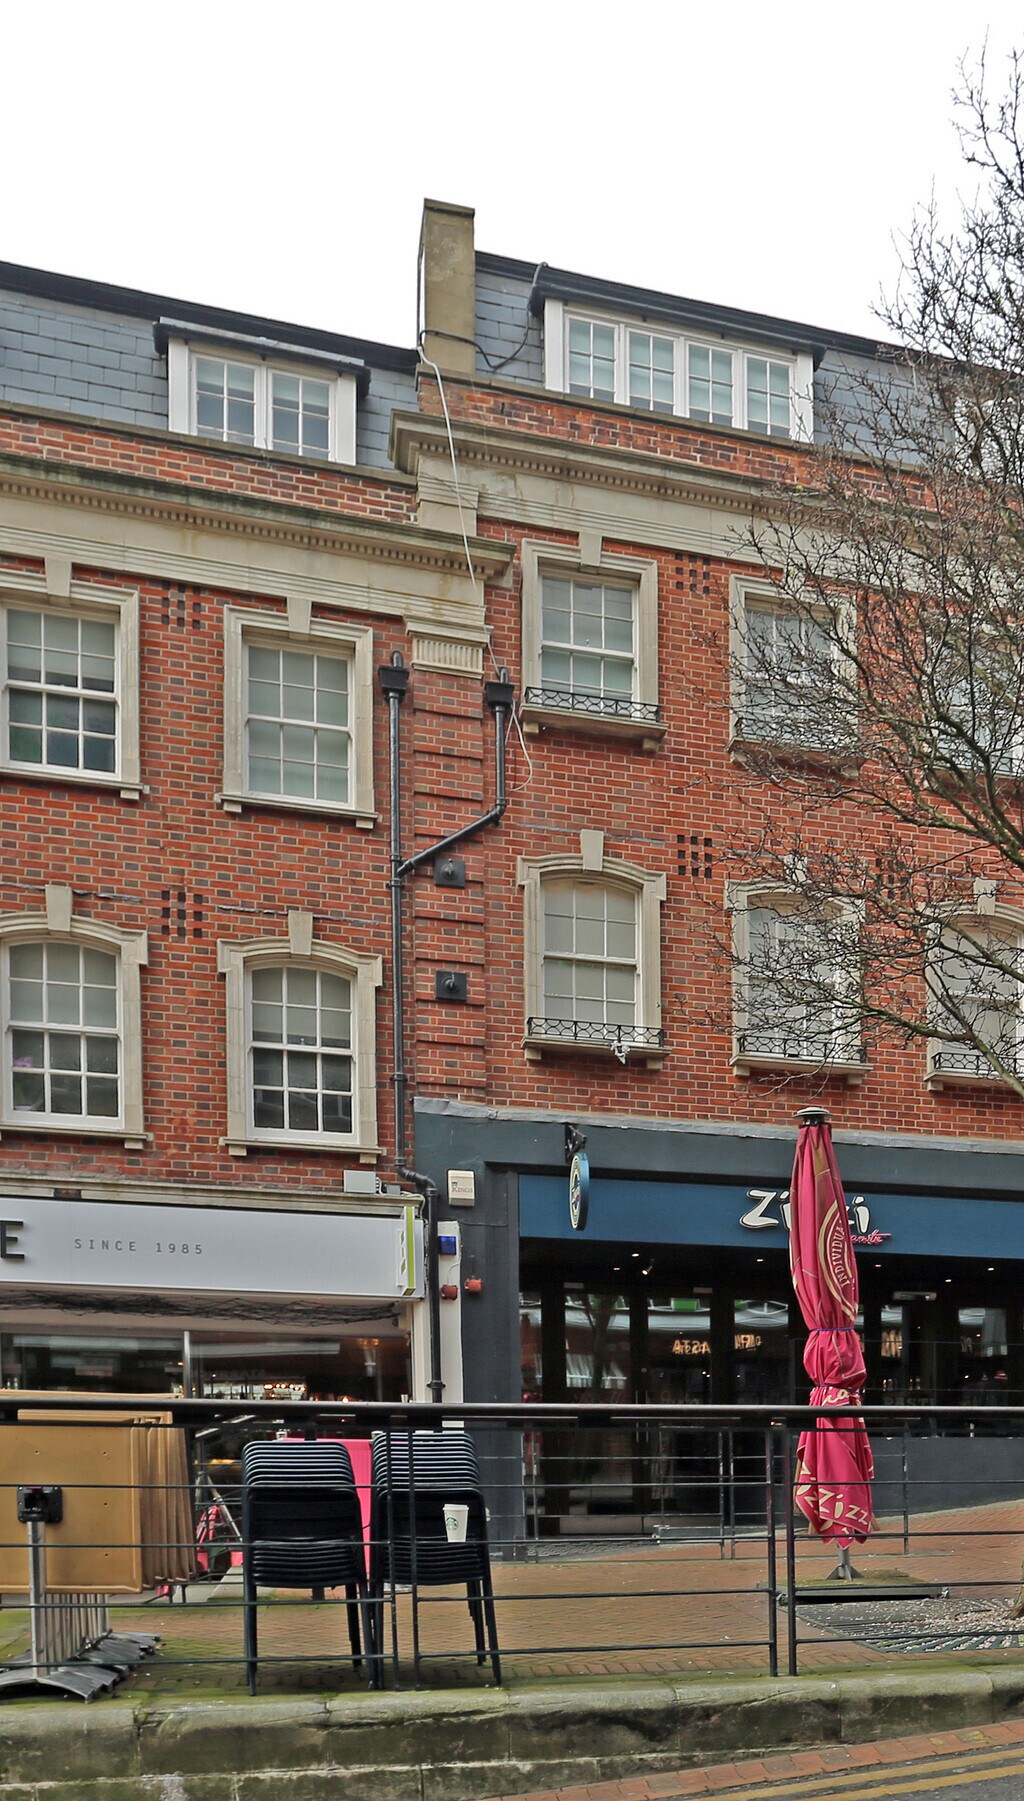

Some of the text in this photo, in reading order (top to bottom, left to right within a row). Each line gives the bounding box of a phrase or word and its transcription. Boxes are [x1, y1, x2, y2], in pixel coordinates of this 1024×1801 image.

[740, 1189, 870, 1234] Zii
[74, 1238, 203, 1255] SINCE 1985
[818, 1487, 869, 1526] Zizz
